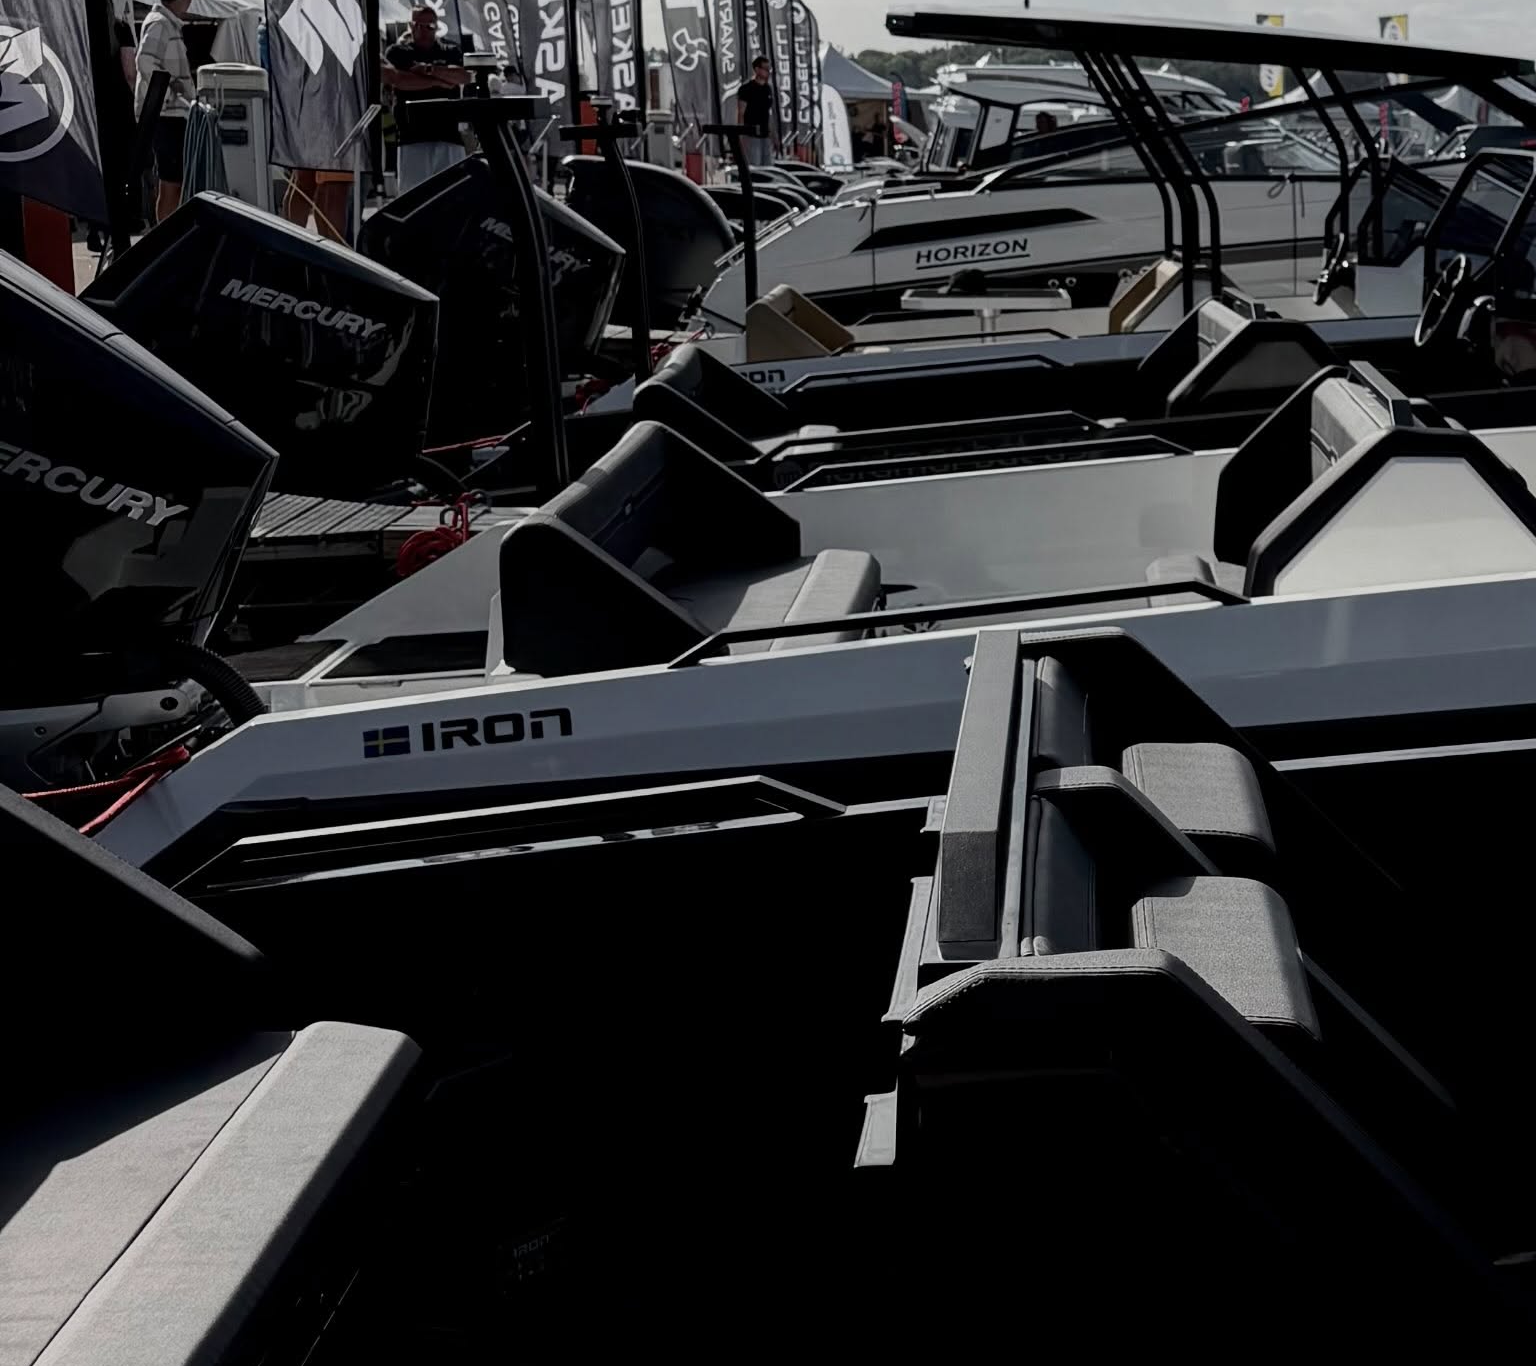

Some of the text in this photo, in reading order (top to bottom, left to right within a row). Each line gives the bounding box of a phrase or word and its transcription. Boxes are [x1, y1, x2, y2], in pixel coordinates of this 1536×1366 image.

[916, 238, 1028, 264] HORIZON
[219, 278, 387, 337] MERCURY
[0, 440, 190, 526] ERCURY
[423, 707, 573, 751] IRON
